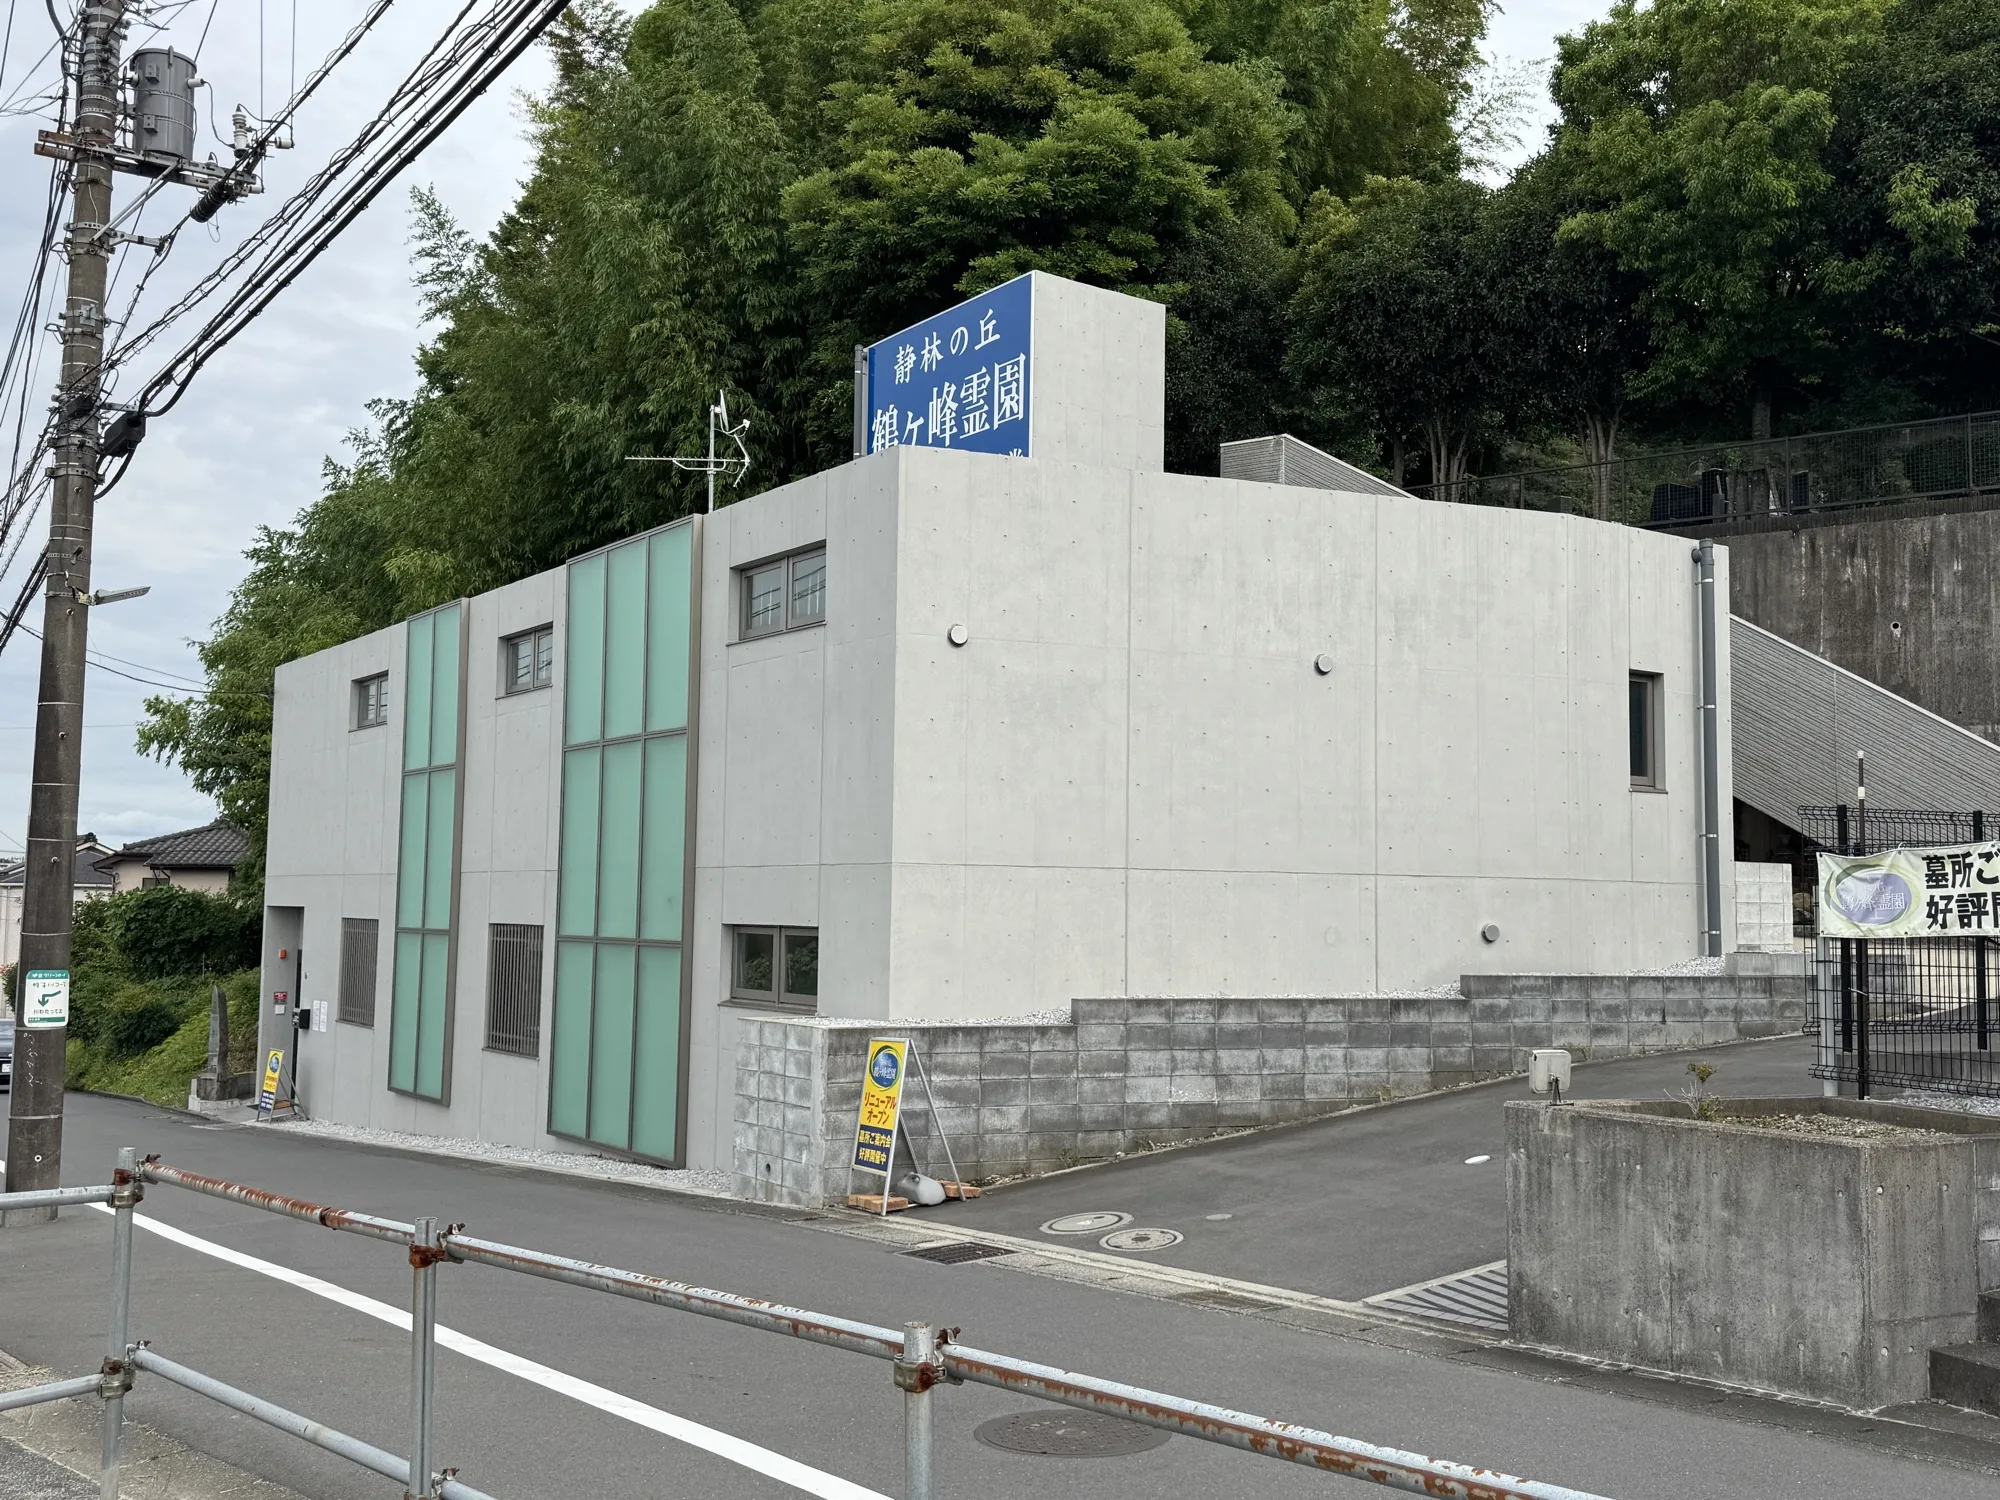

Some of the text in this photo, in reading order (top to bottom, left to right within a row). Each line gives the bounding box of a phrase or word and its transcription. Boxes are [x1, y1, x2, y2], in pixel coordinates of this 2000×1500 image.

[894, 308, 1001, 385] 静林の丘
[864, 1092, 897, 1110] リニューアル
[867, 1108, 890, 1125] オープン
